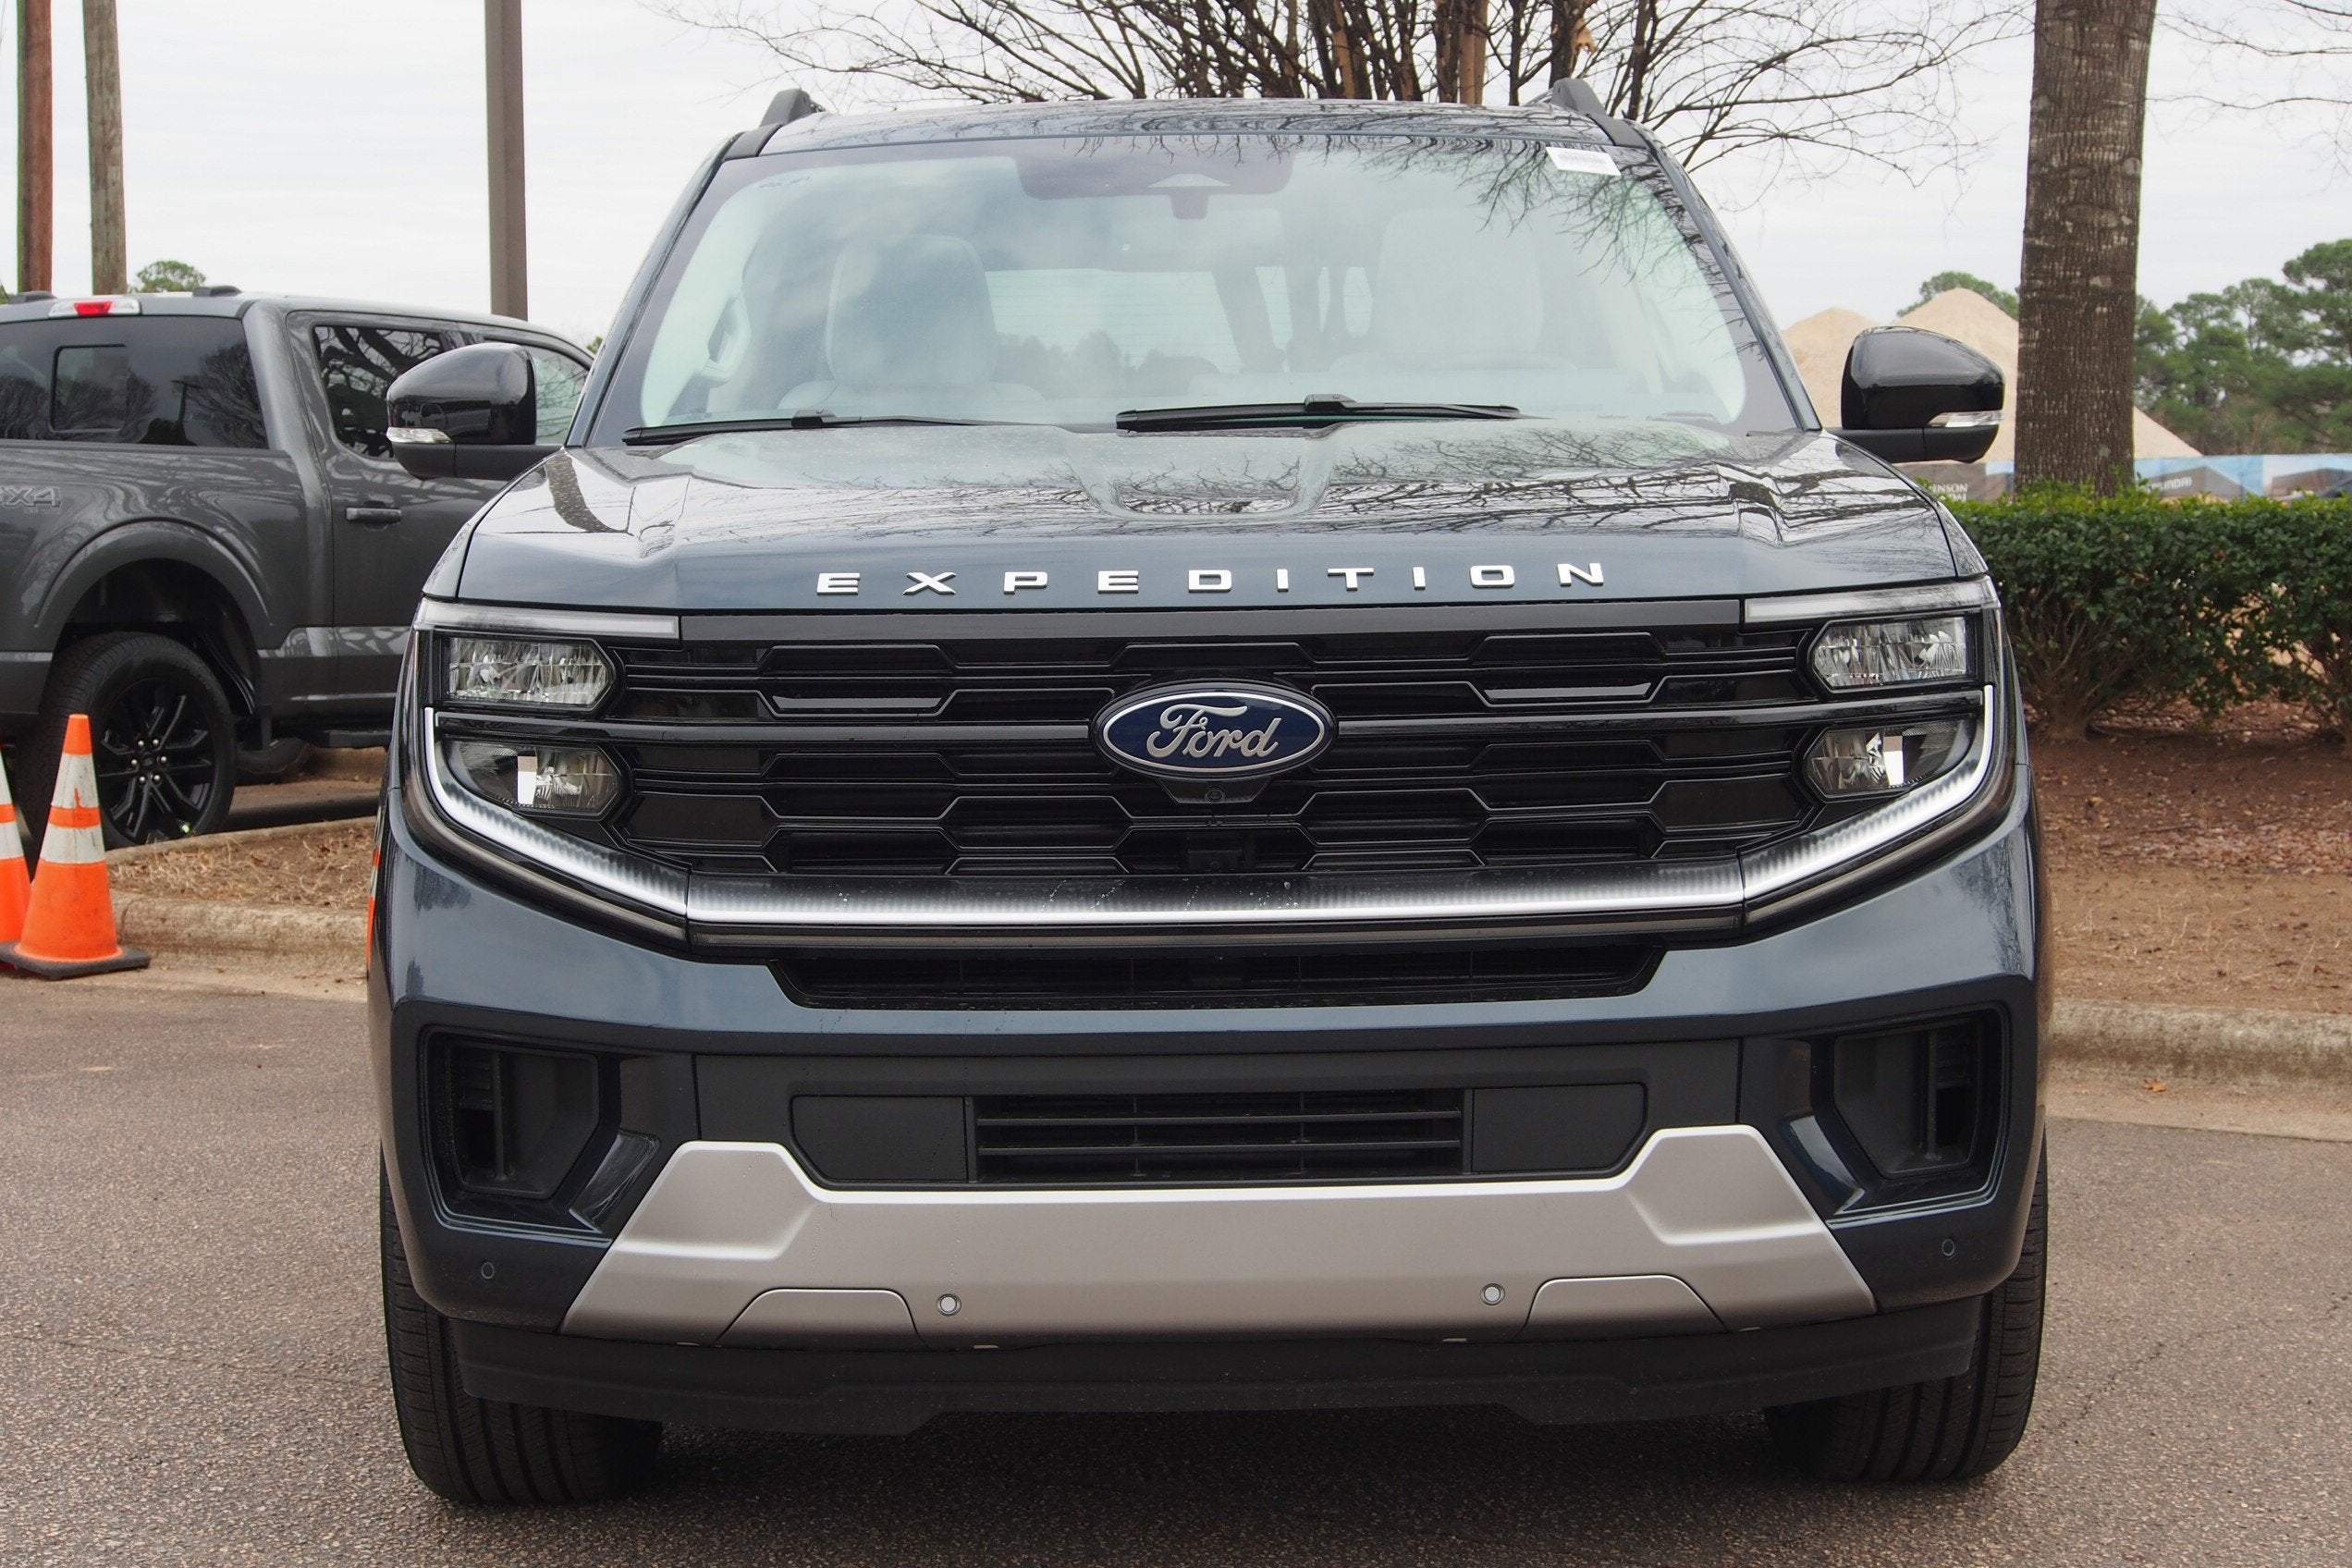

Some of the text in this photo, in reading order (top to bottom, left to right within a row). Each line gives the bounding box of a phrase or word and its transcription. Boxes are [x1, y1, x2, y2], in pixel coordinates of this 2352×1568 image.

[0, 487, 62, 508] X4
[1932, 483, 1968, 494] INSON
[816, 562, 1605, 595] EXPEDITION
[1146, 704, 1282, 759] Ford
